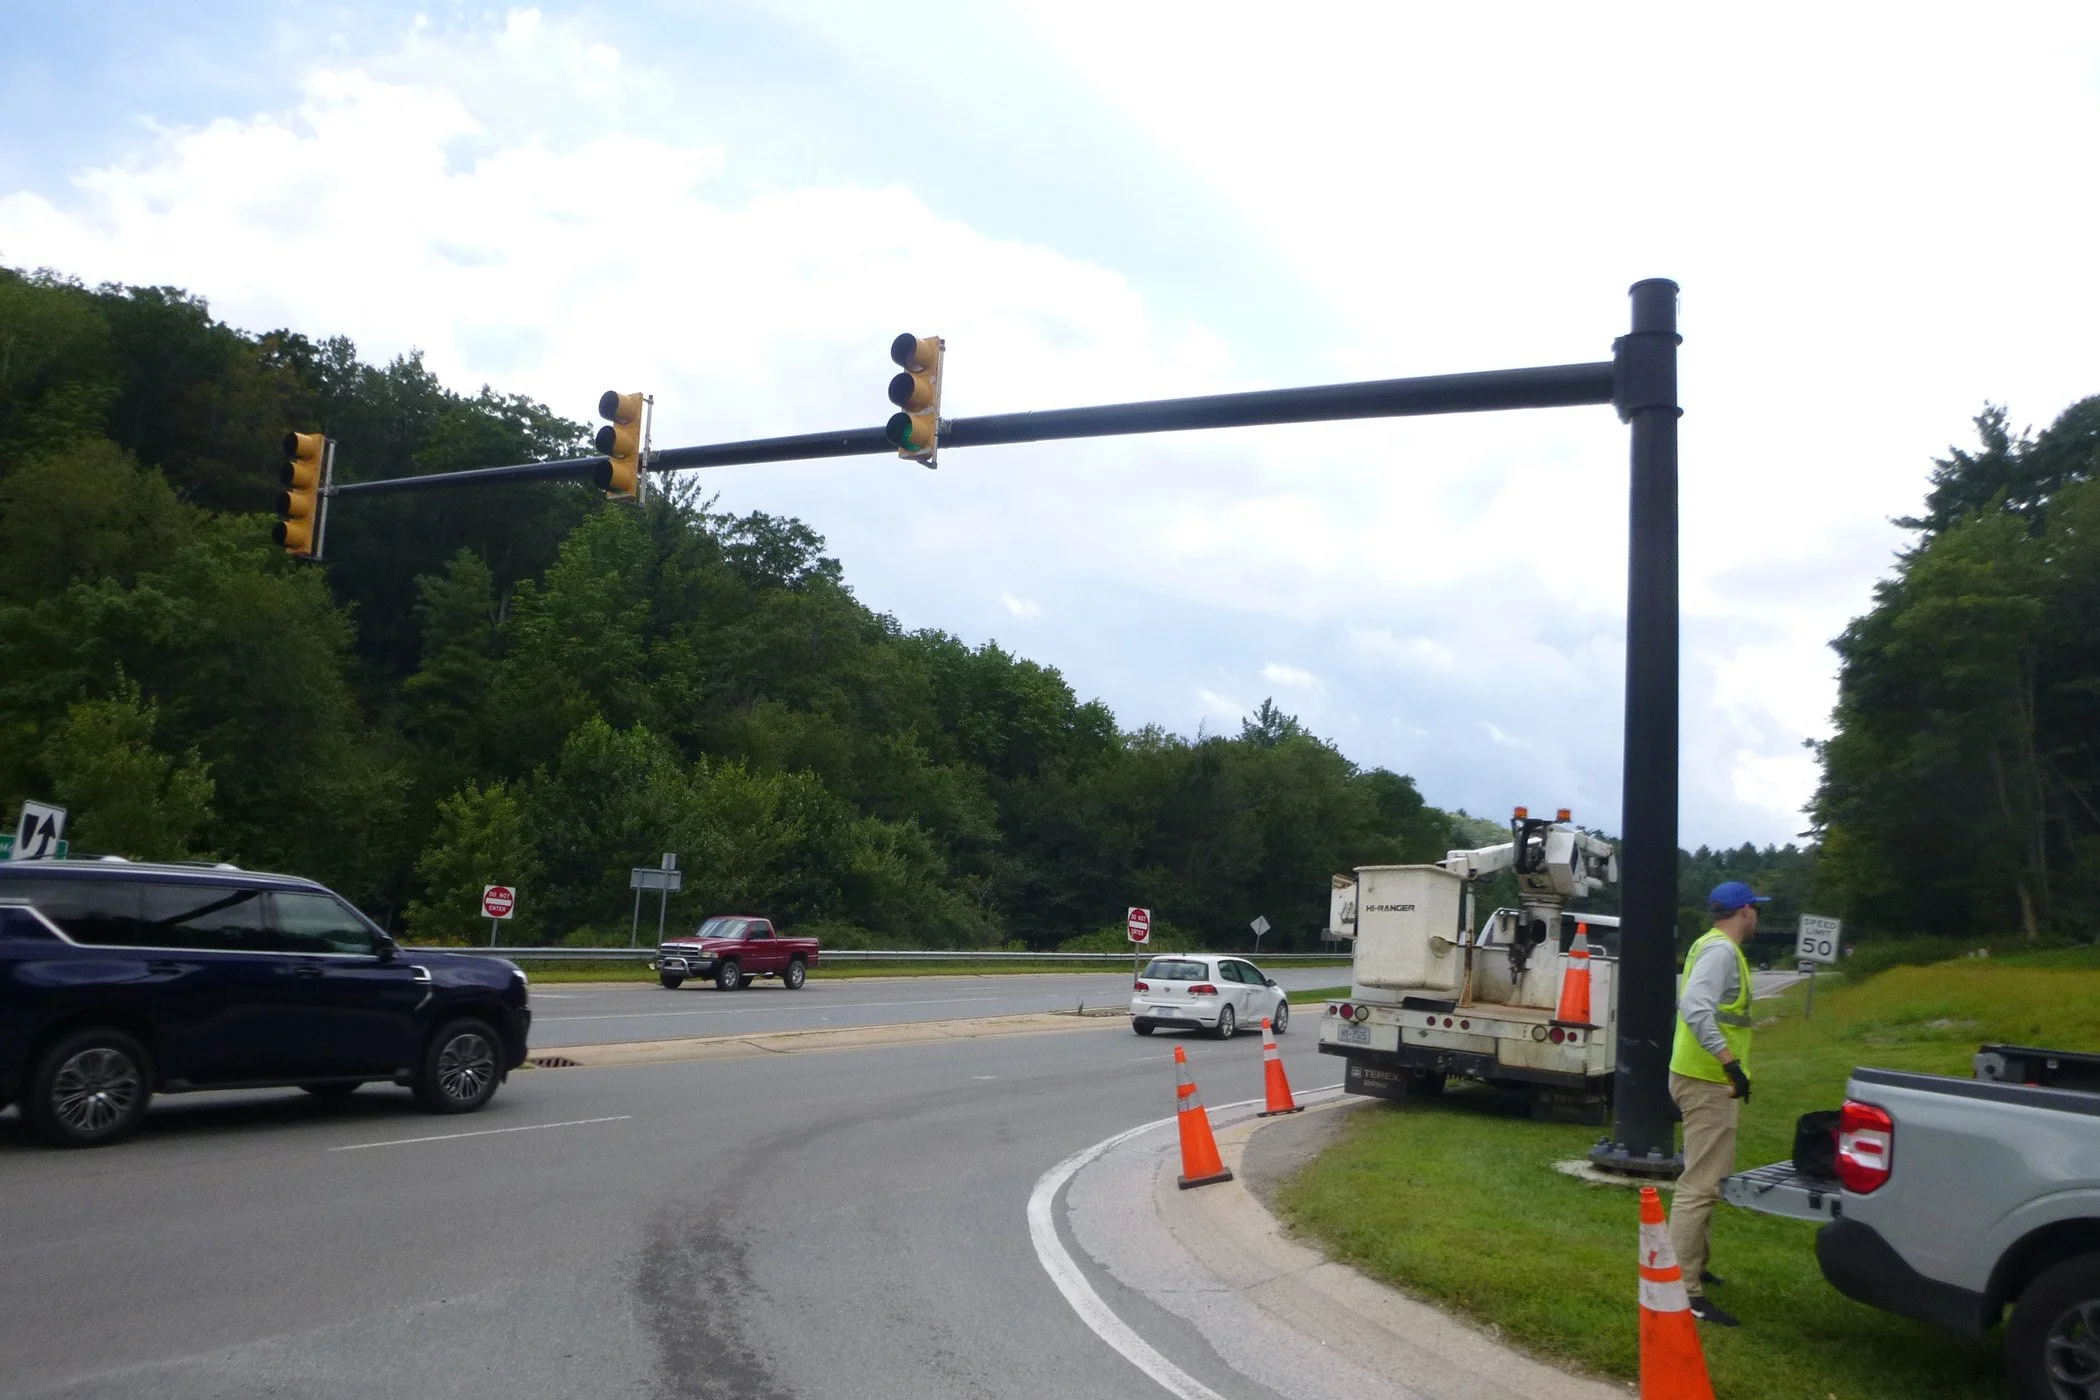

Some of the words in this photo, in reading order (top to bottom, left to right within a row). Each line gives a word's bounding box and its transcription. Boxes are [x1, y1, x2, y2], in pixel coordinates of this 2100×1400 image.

[1365, 904, 1416, 912] HI-RANGER
[1804, 918, 1836, 930] SPEED
[1131, 928, 1144, 936] ENTER
[1806, 927, 1832, 937] LIMIT
[1801, 937, 1832, 956] 50
[1363, 1069, 1400, 1081] TEREX
